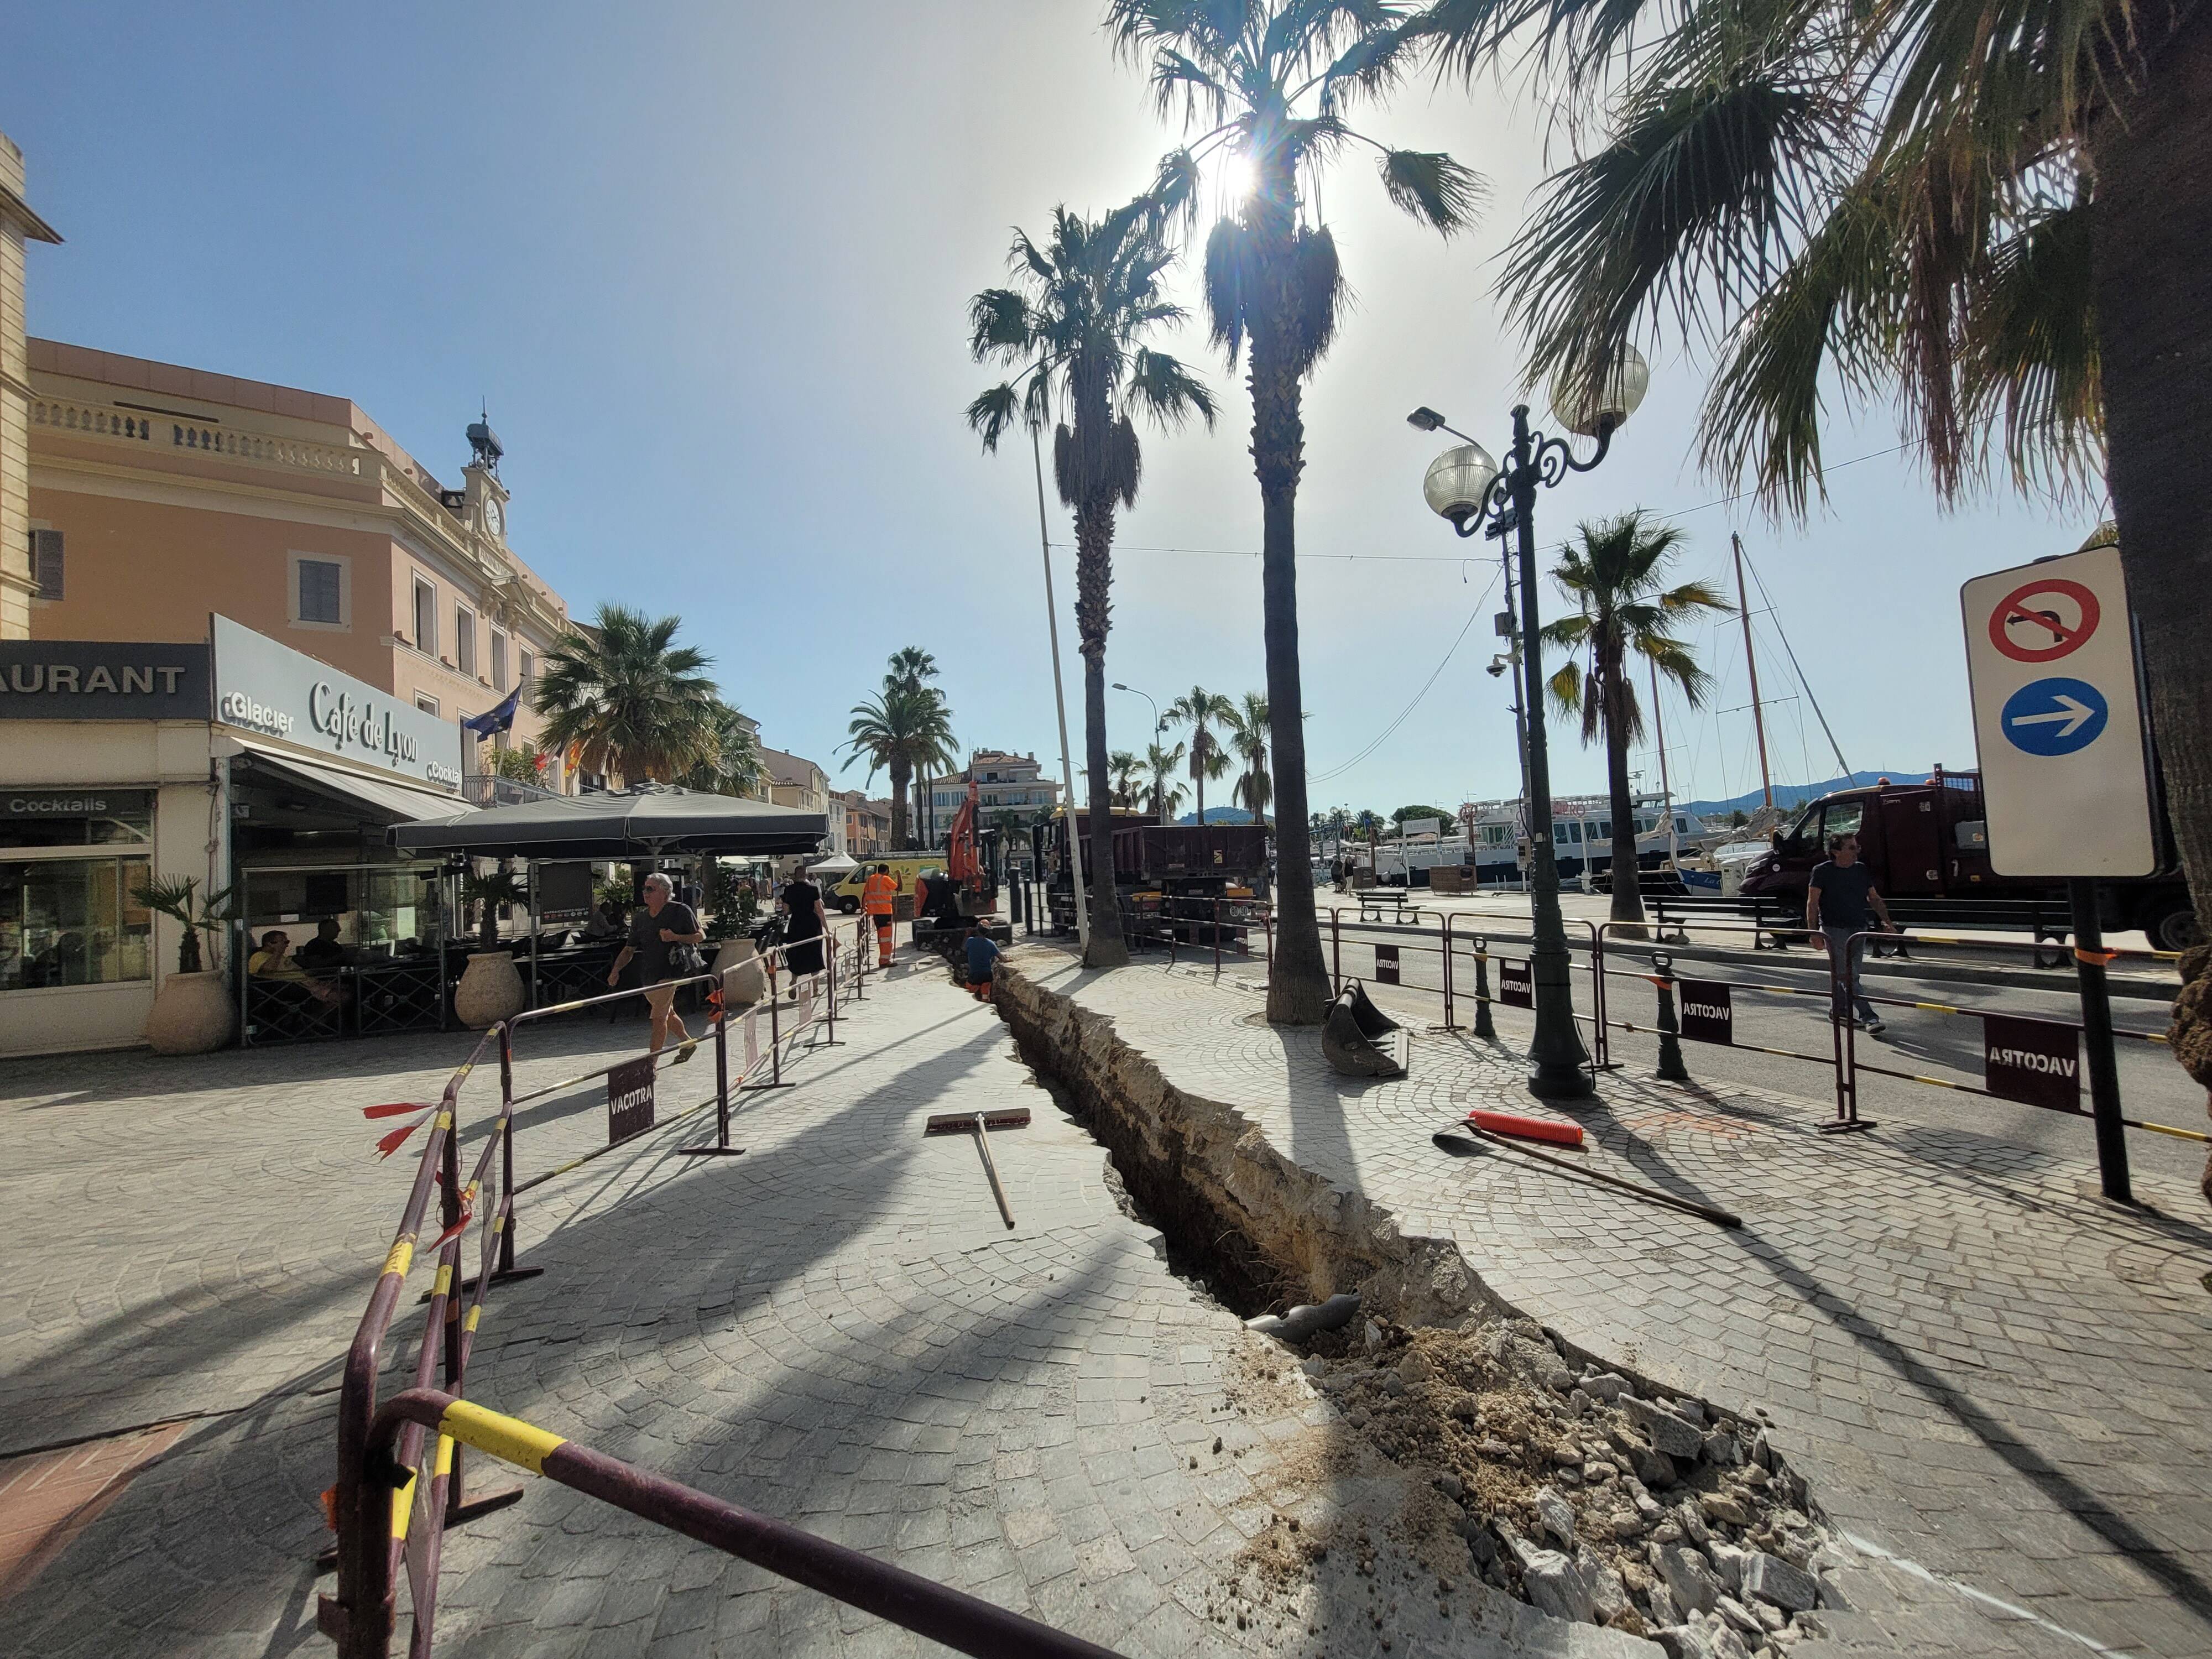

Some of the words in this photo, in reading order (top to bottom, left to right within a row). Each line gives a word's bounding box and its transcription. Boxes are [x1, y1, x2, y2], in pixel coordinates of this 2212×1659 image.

[0, 664, 186, 693] URANT
[231, 691, 295, 733] Glacier
[314, 681, 359, 748] Café
[364, 702, 382, 748] de
[388, 710, 419, 764] Lyon
[9, 798, 107, 812] Cocktails
[1231, 907, 1238, 916] 80
[1240, 906, 1247, 915] 90
[611, 1085, 653, 1115] VACOTRA
